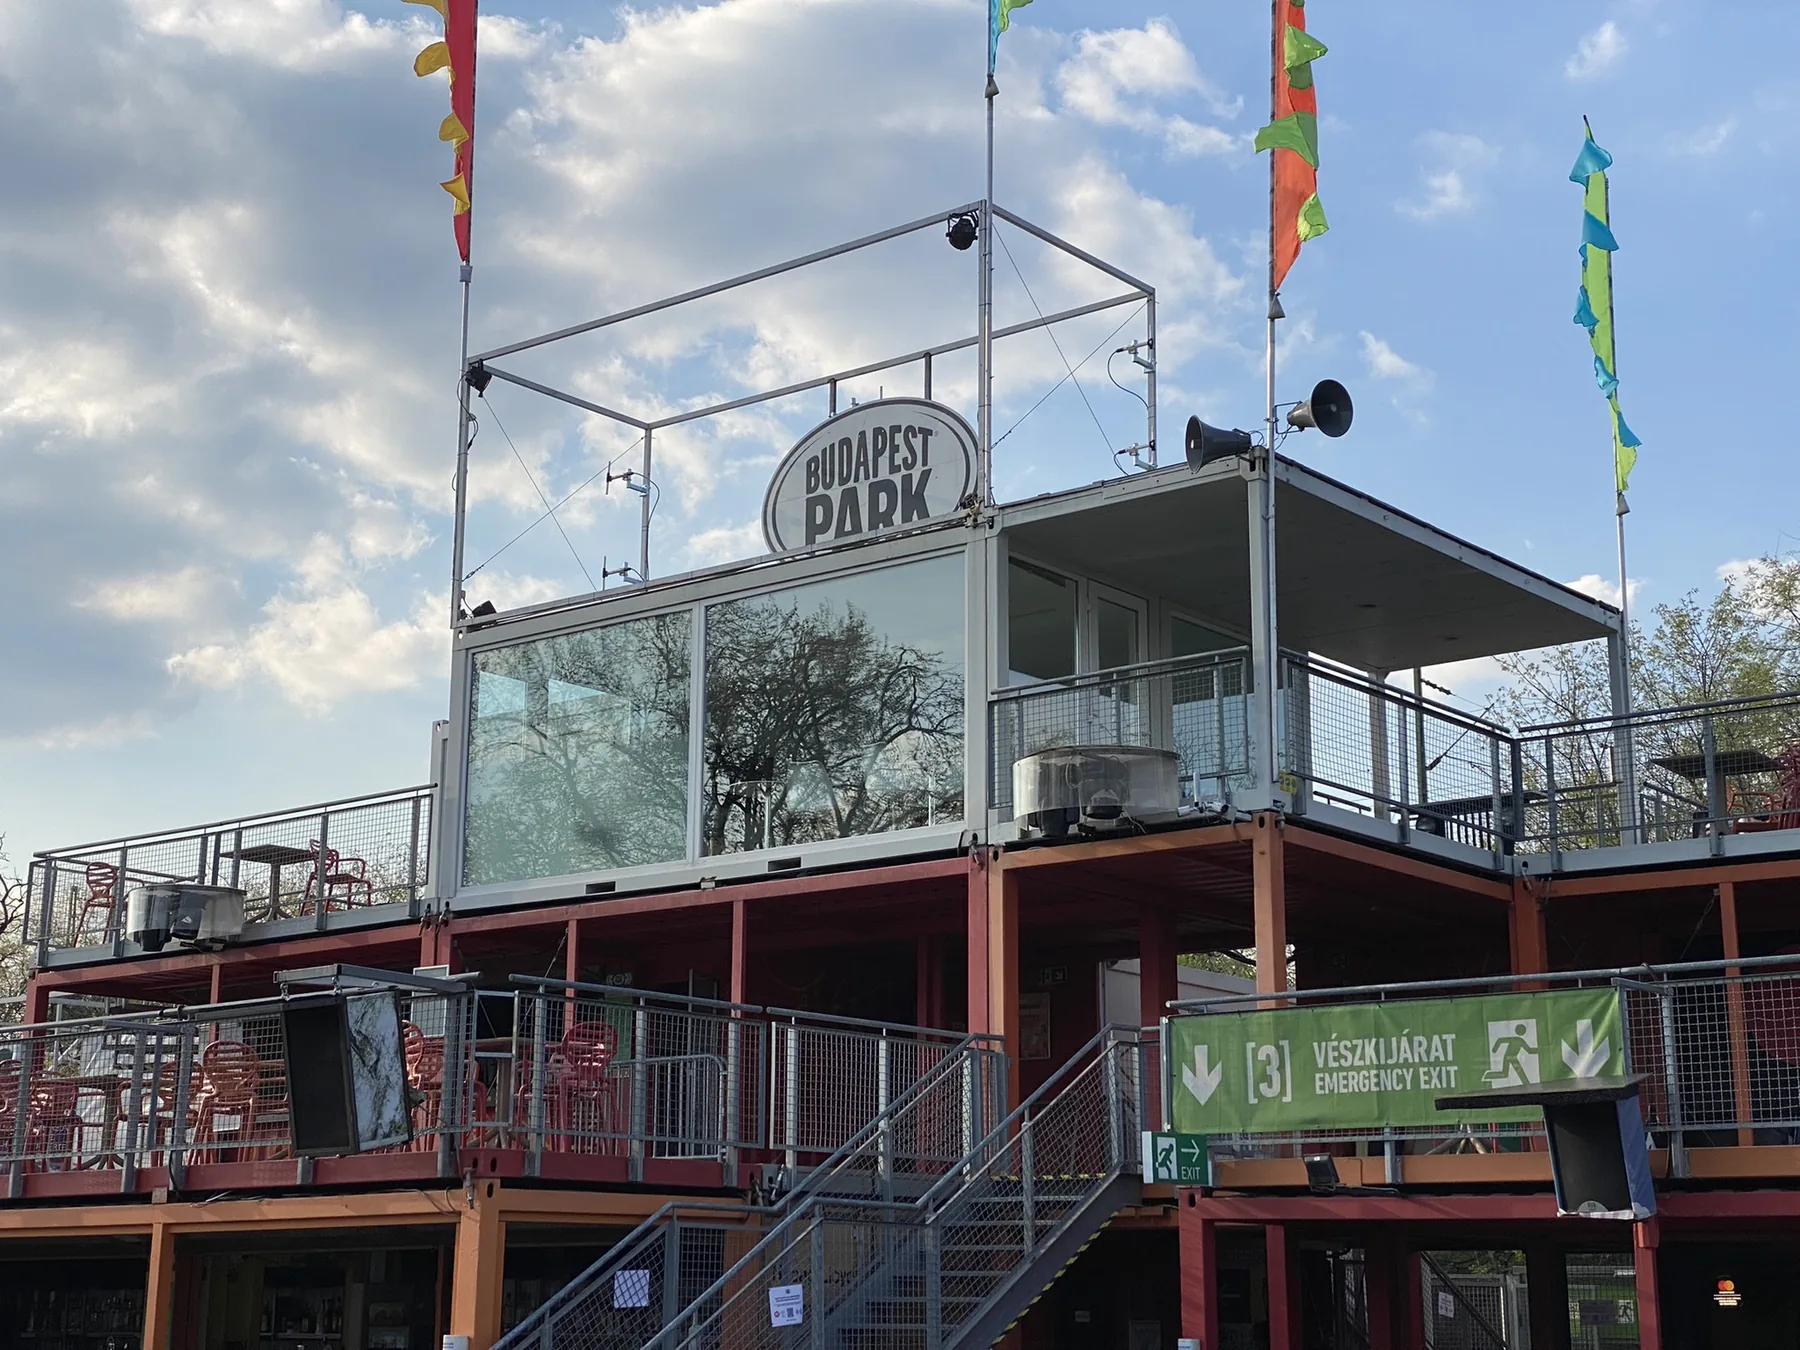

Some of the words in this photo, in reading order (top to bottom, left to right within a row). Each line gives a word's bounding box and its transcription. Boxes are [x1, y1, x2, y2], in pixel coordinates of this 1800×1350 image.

[806, 425, 933, 495] BUDAPEST
[805, 468, 933, 546] PARK
[1312, 1028, 1456, 1068] VÉSZKIJÁRAT
[1315, 1067, 1414, 1095] EMERGENCY
[1419, 1066, 1458, 1090] EXIT
[1181, 1166, 1200, 1180] EXIT
